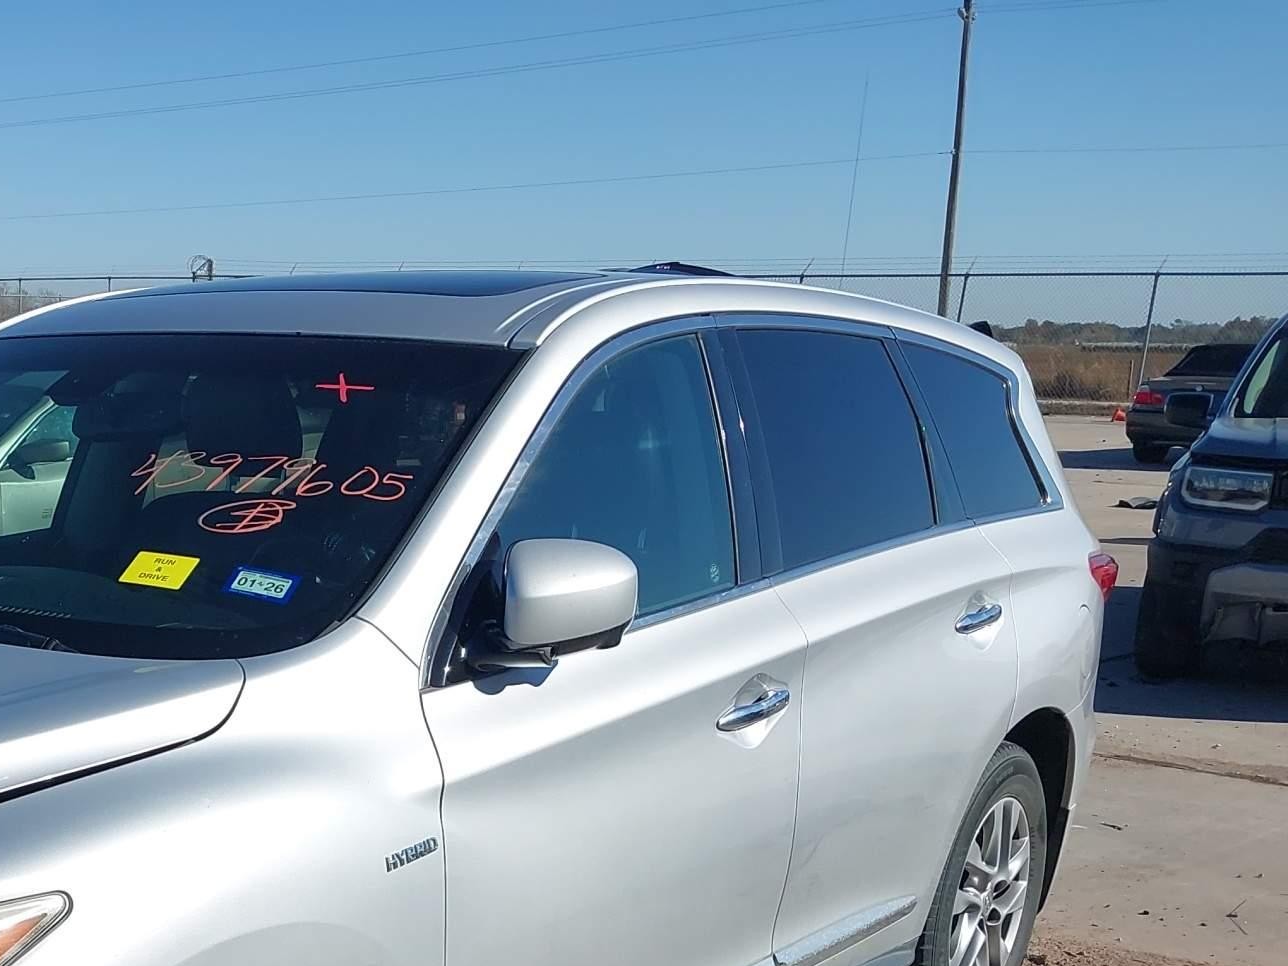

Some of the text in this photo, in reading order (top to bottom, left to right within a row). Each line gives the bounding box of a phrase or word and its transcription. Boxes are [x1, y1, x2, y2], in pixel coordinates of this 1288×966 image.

[130, 450, 414, 501] 43979605
[153, 557, 177, 566] RUN
[137, 572, 170, 582] DRIVE
[236, 576, 286, 594] 01 26
[385, 836, 439, 873] HYBRID
